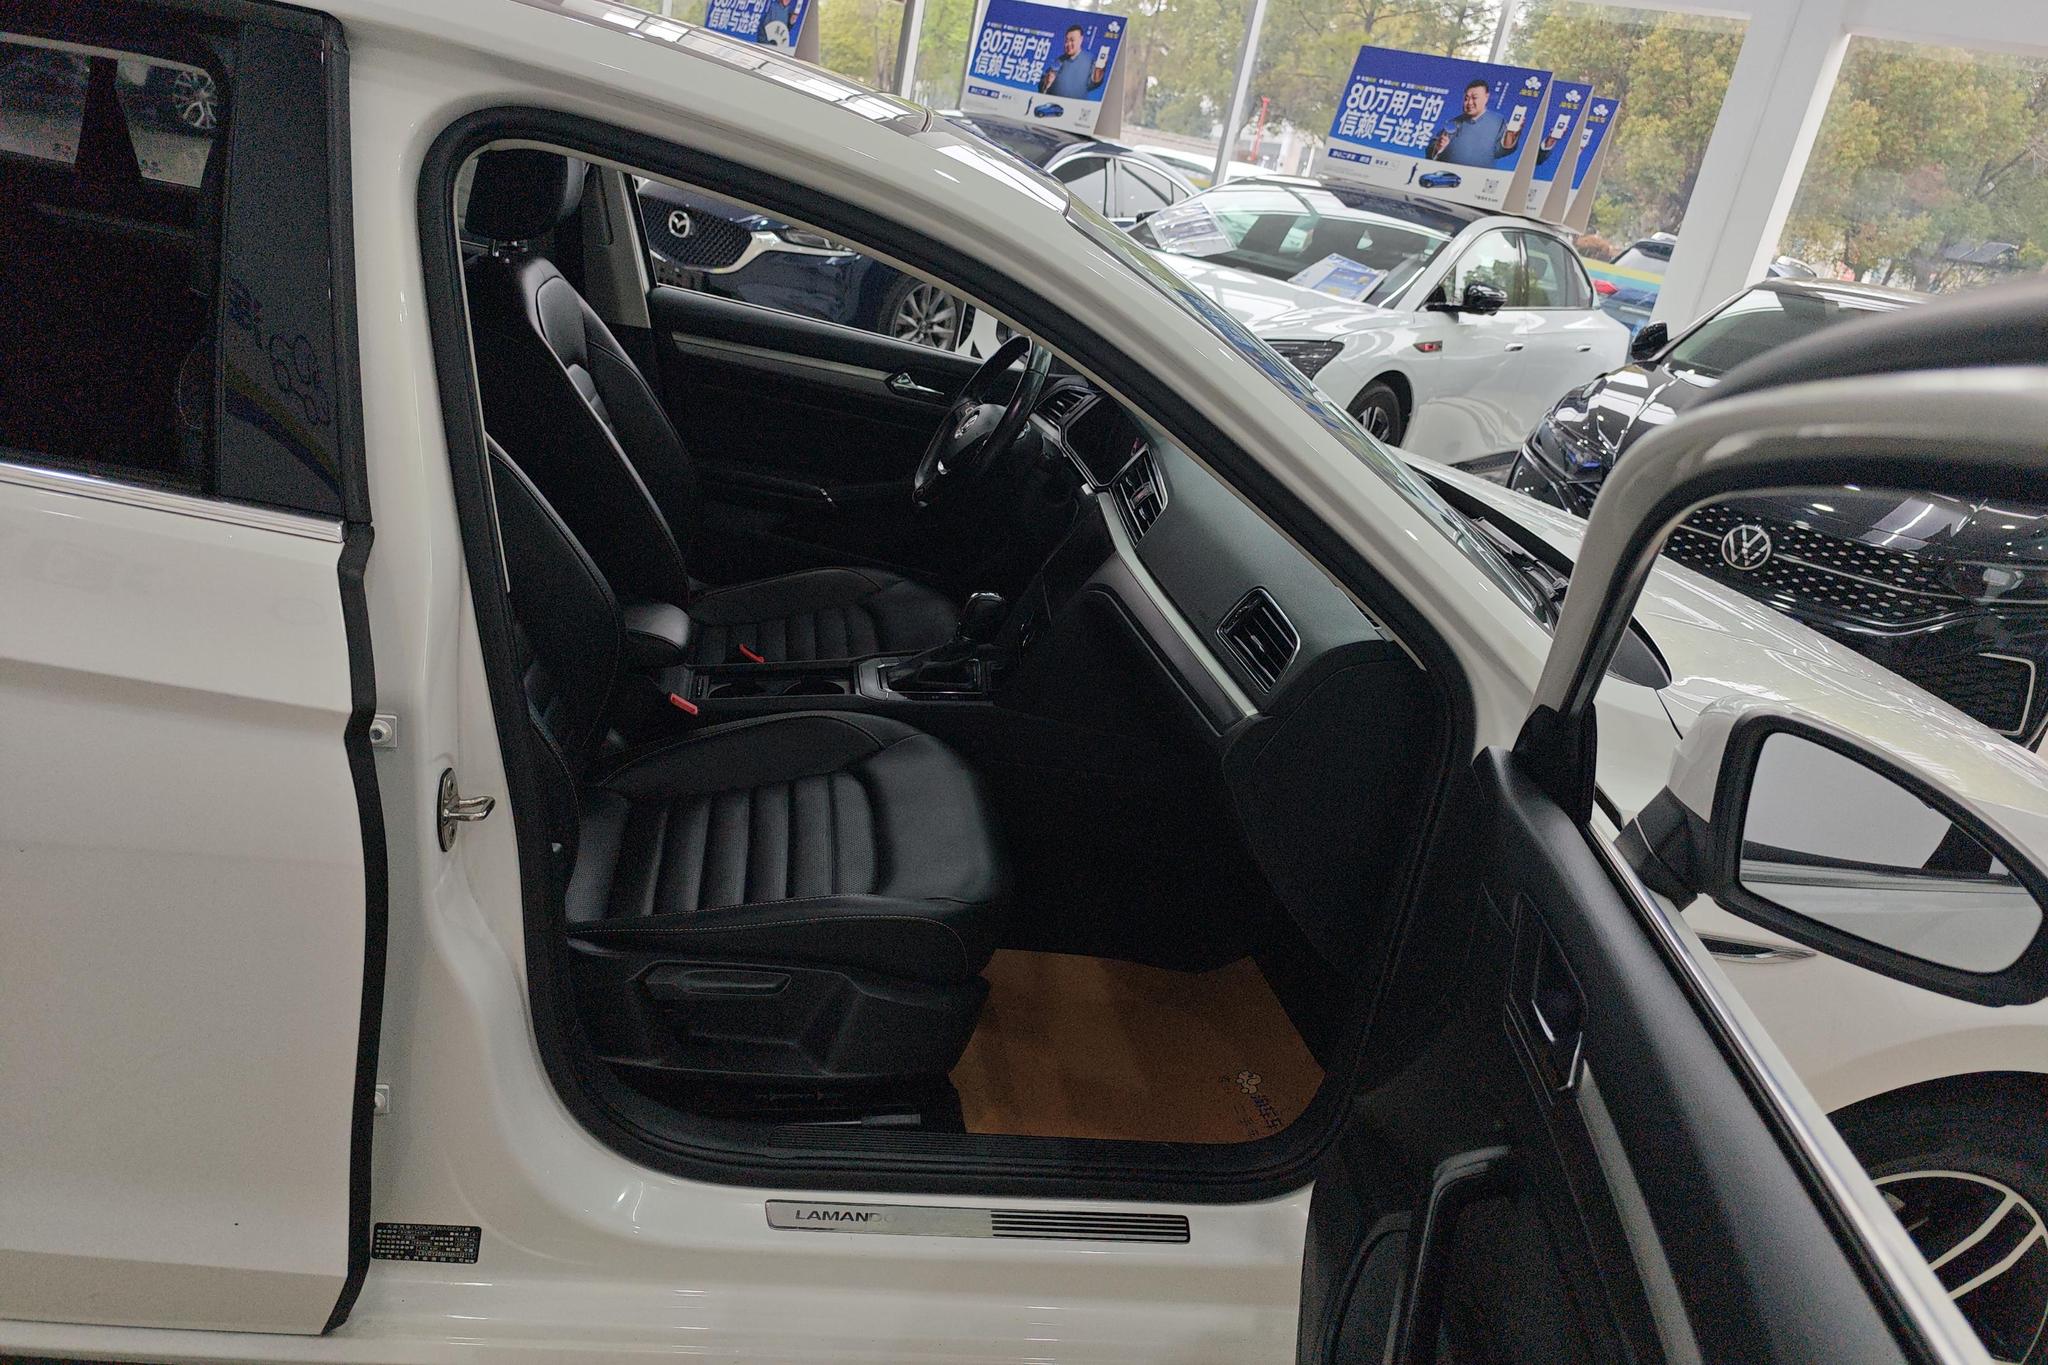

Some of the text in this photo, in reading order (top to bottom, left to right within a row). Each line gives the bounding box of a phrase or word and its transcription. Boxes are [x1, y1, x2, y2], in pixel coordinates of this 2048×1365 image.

[708, 8, 761, 35] 信赖与选择
[980, 29, 1051, 60] 80万用户的
[974, 51, 1045, 85] 信赖与选择
[1346, 83, 1444, 122] 80万用户的
[1337, 109, 1435, 149] 信赖与选择
